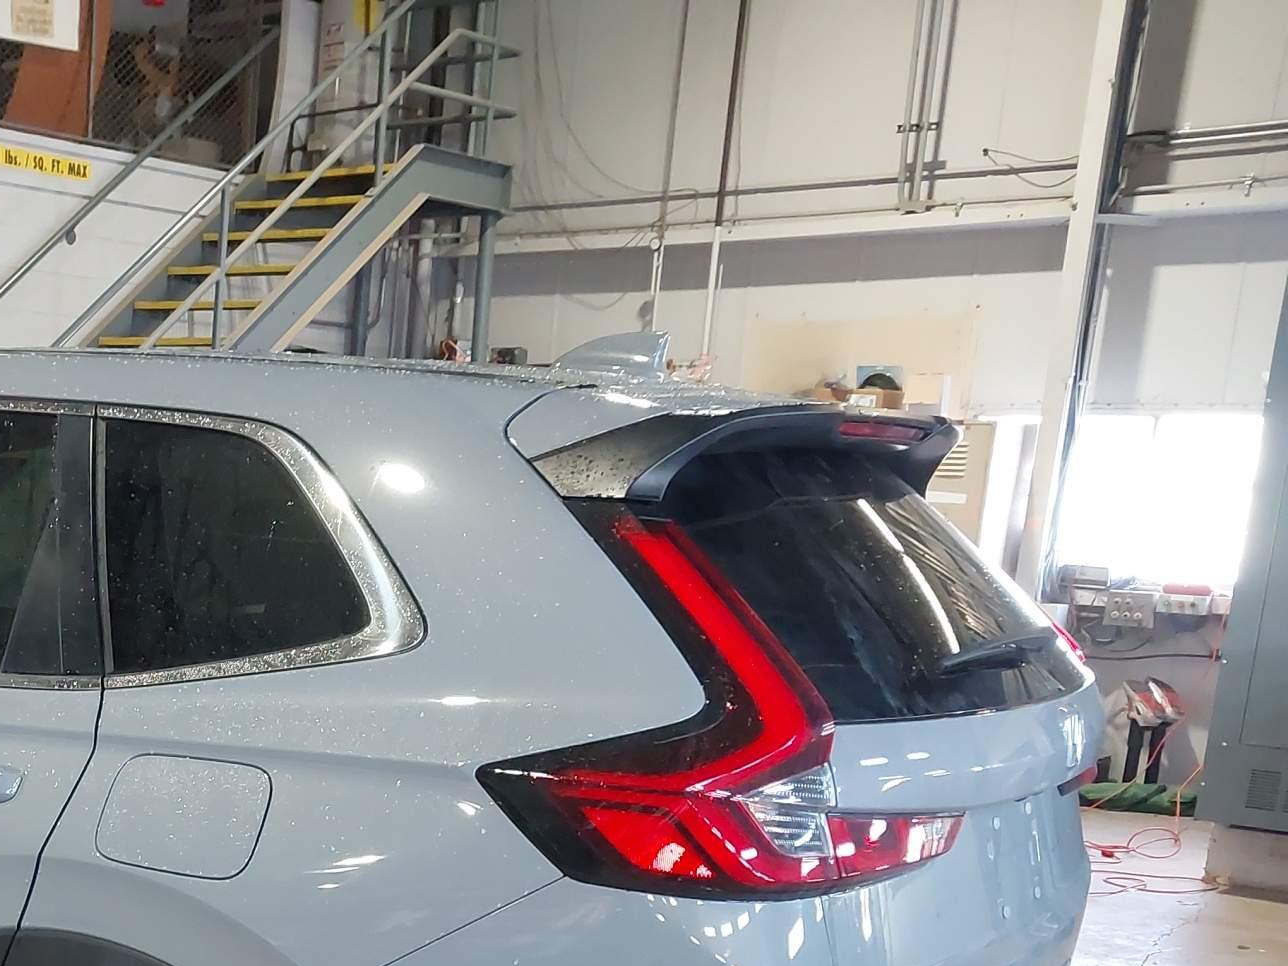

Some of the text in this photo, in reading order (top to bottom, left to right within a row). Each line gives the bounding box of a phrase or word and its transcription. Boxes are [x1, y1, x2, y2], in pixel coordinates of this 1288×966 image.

[4, 149, 22, 167] lbs.
[33, 155, 48, 172] SQ.
[51, 158, 65, 175] FT.
[67, 162, 88, 179] MAX
